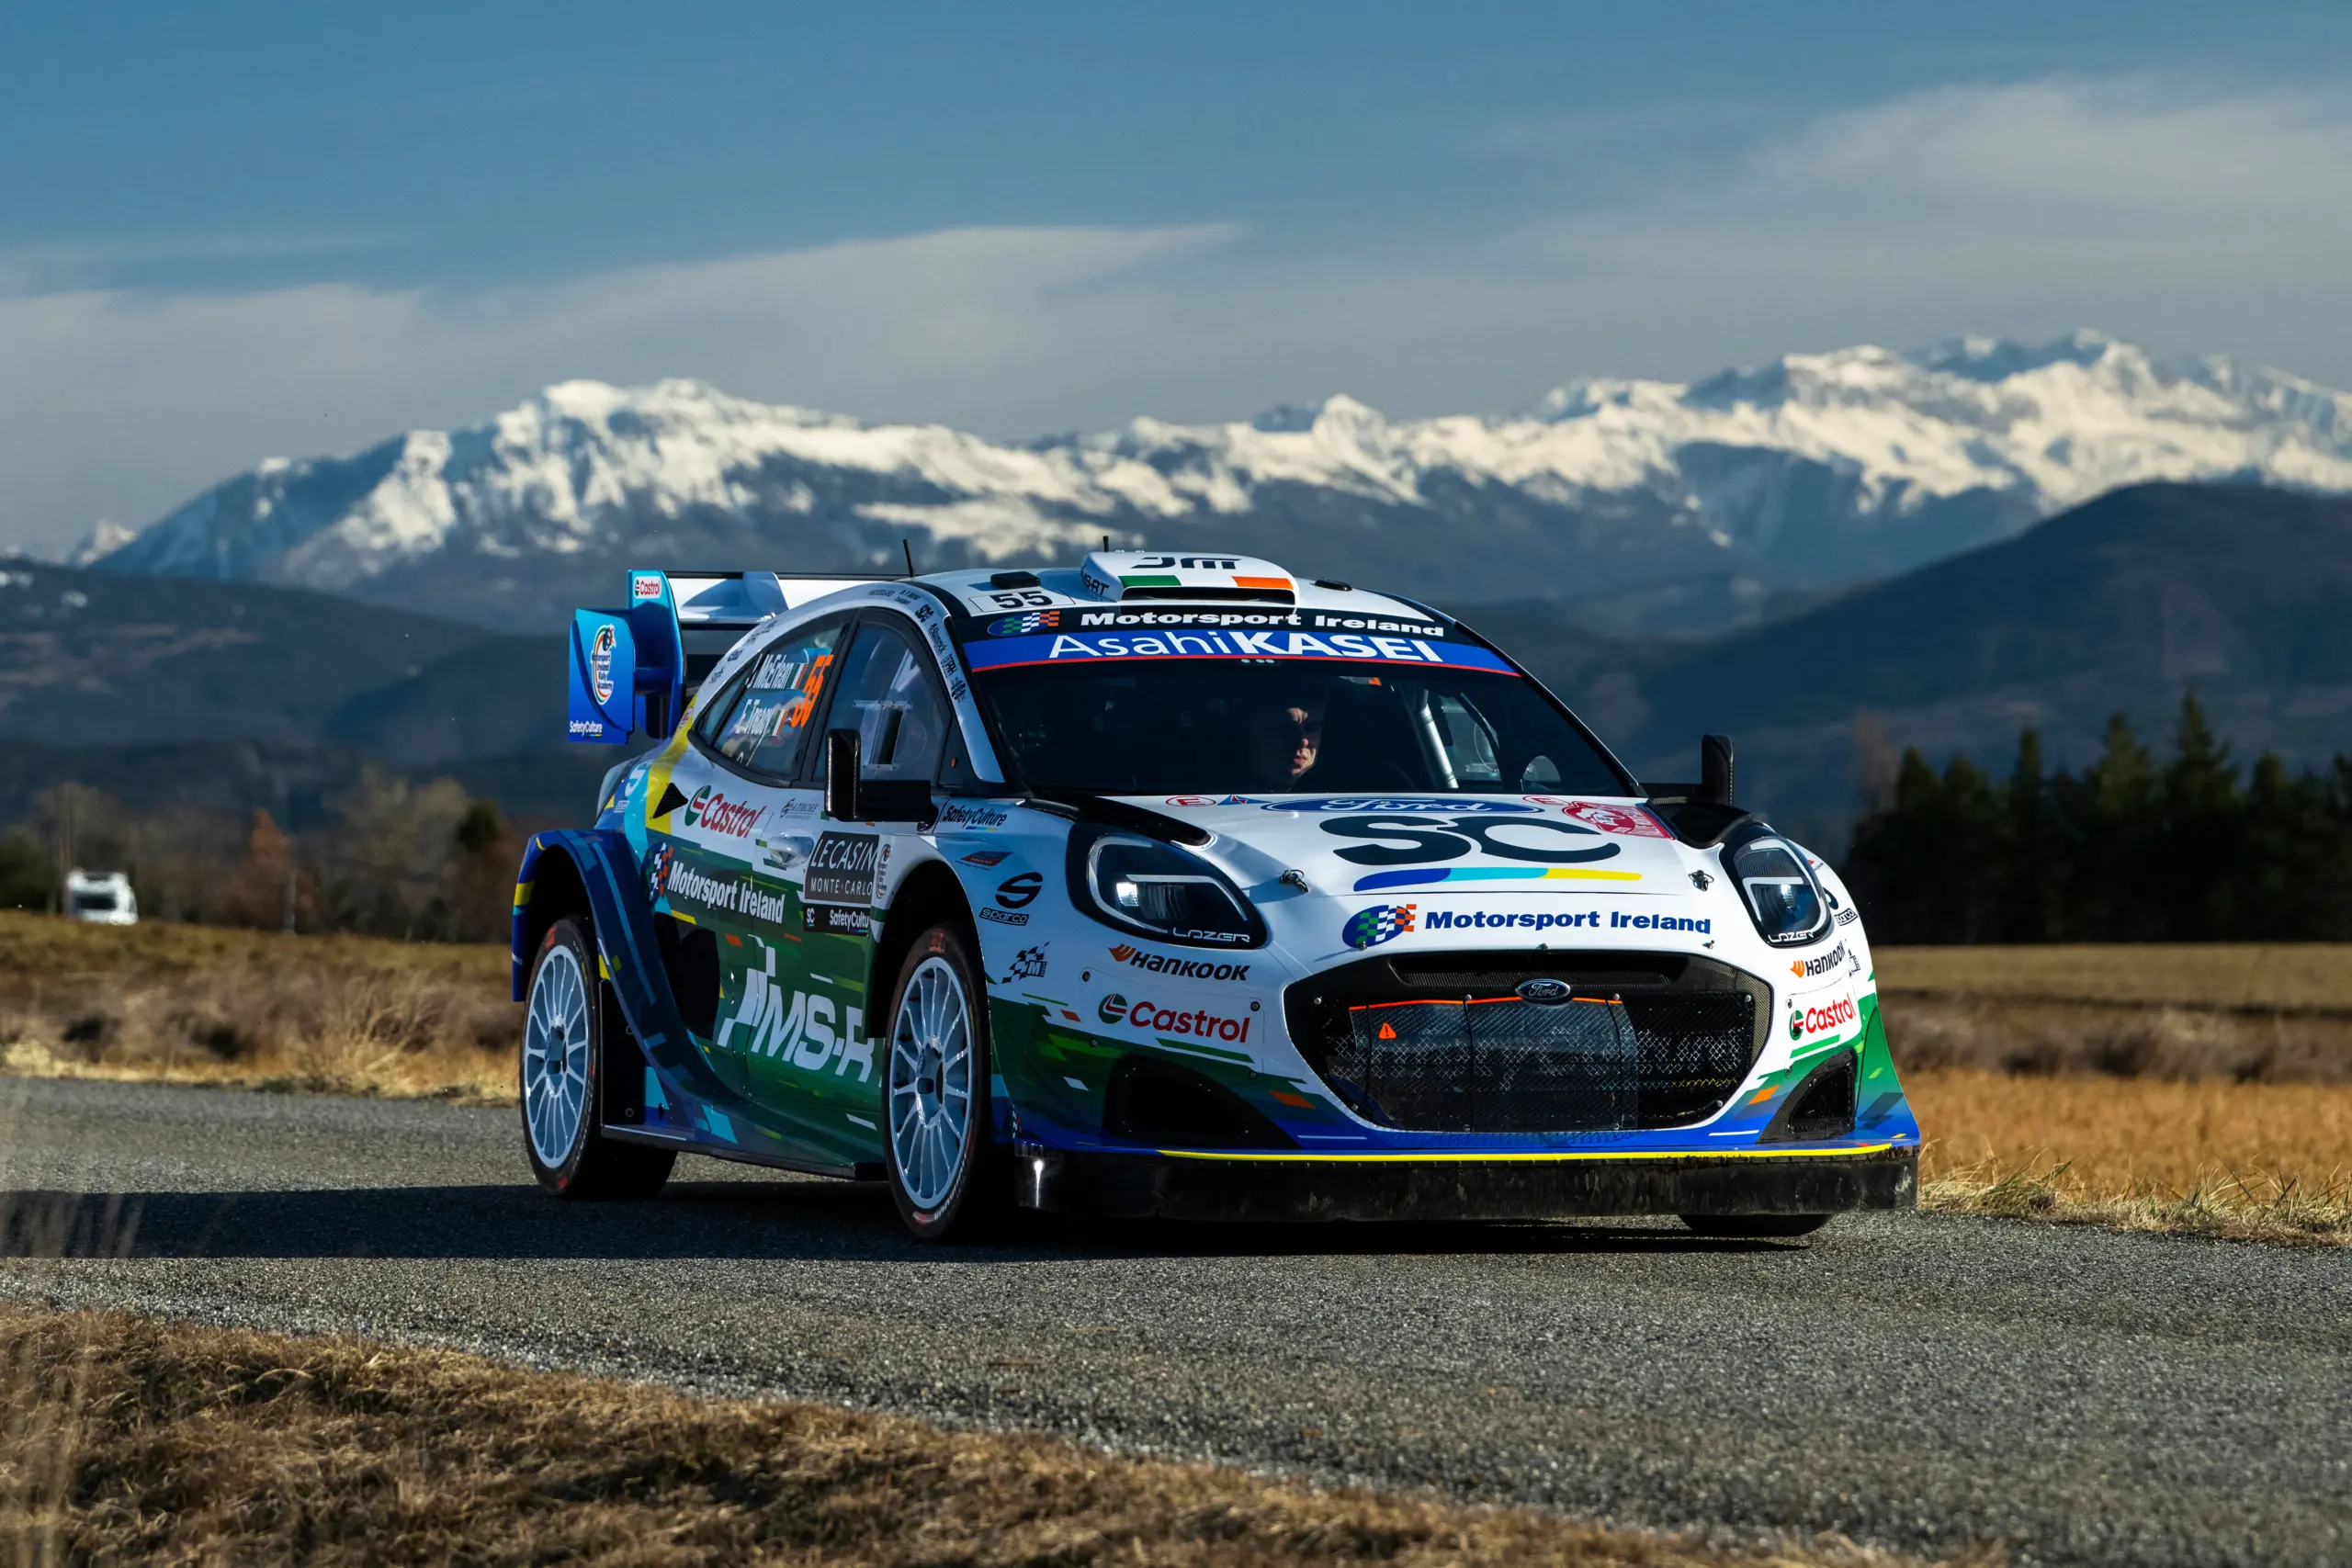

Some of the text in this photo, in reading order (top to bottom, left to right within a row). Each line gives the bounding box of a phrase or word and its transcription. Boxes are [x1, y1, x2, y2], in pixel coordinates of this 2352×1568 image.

[639, 581, 661, 595] Castrol
[989, 591, 1053, 609] 55
[1080, 612, 1444, 637] Motorsport Ireland
[791, 654, 835, 728] 55
[569, 720, 603, 736] SafetyCulture
[701, 793, 767, 838] Castrol
[943, 804, 1007, 827] SafetyCulture
[1319, 797, 1492, 811] Ford
[1319, 815, 1621, 866] SC
[829, 840, 878, 872] CASIN
[667, 861, 785, 924] Motorsport Ireland
[830, 908, 869, 931] SafetyCultu
[982, 908, 1028, 924] sparco
[1425, 910, 1711, 934] Motorsport Ireland
[1173, 927, 1250, 942] LAZER
[1768, 931, 1814, 942] LAZER
[1527, 982, 1559, 998] Ford
[1130, 1001, 1250, 1043] Castrol
[1805, 992, 1857, 1033] Castrol
